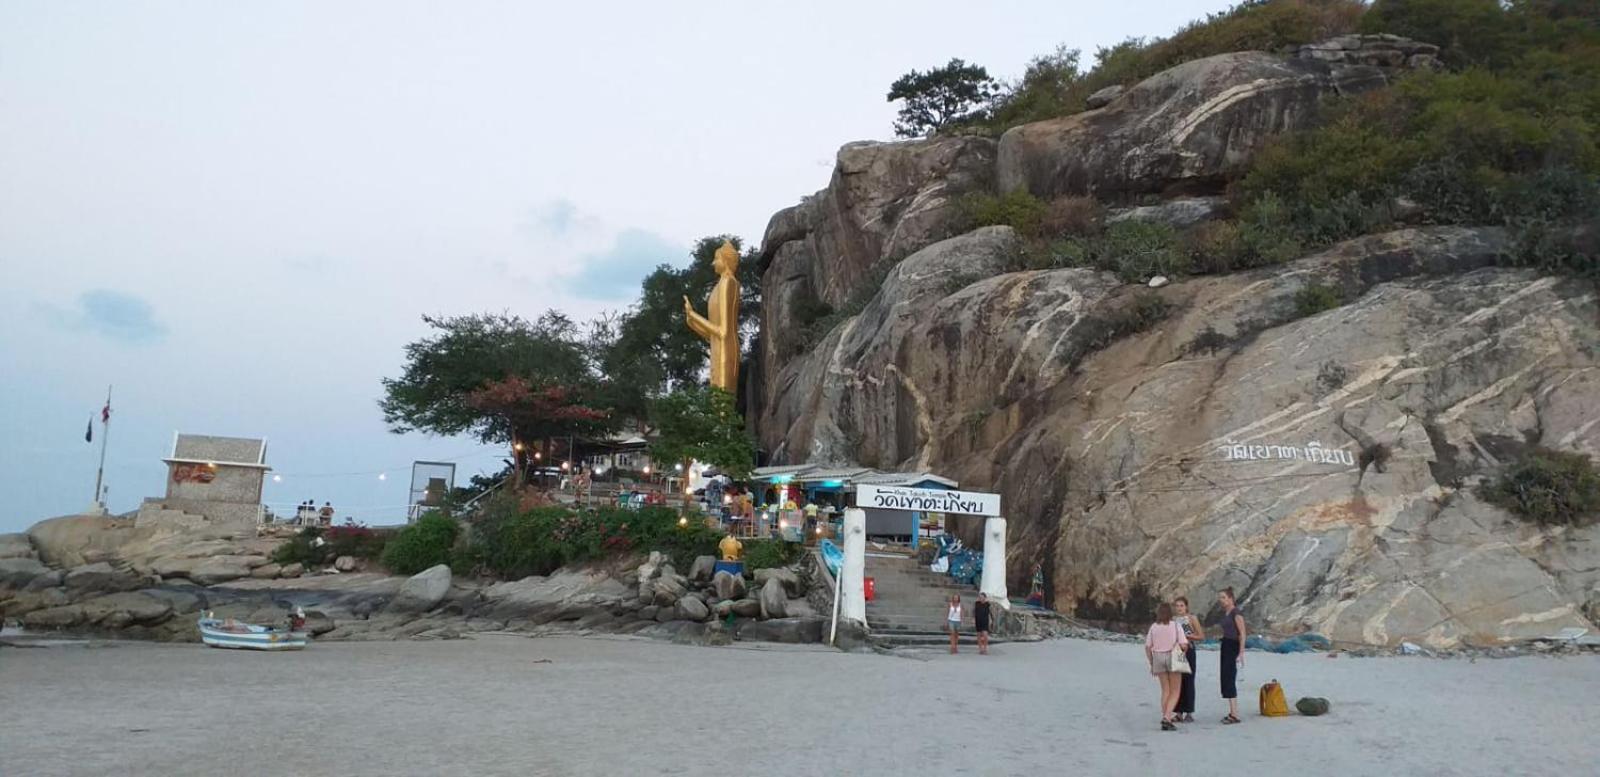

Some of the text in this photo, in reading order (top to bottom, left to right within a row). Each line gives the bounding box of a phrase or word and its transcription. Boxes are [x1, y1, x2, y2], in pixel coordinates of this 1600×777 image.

[874, 489, 983, 513] วัดเขาตะเกียบ
